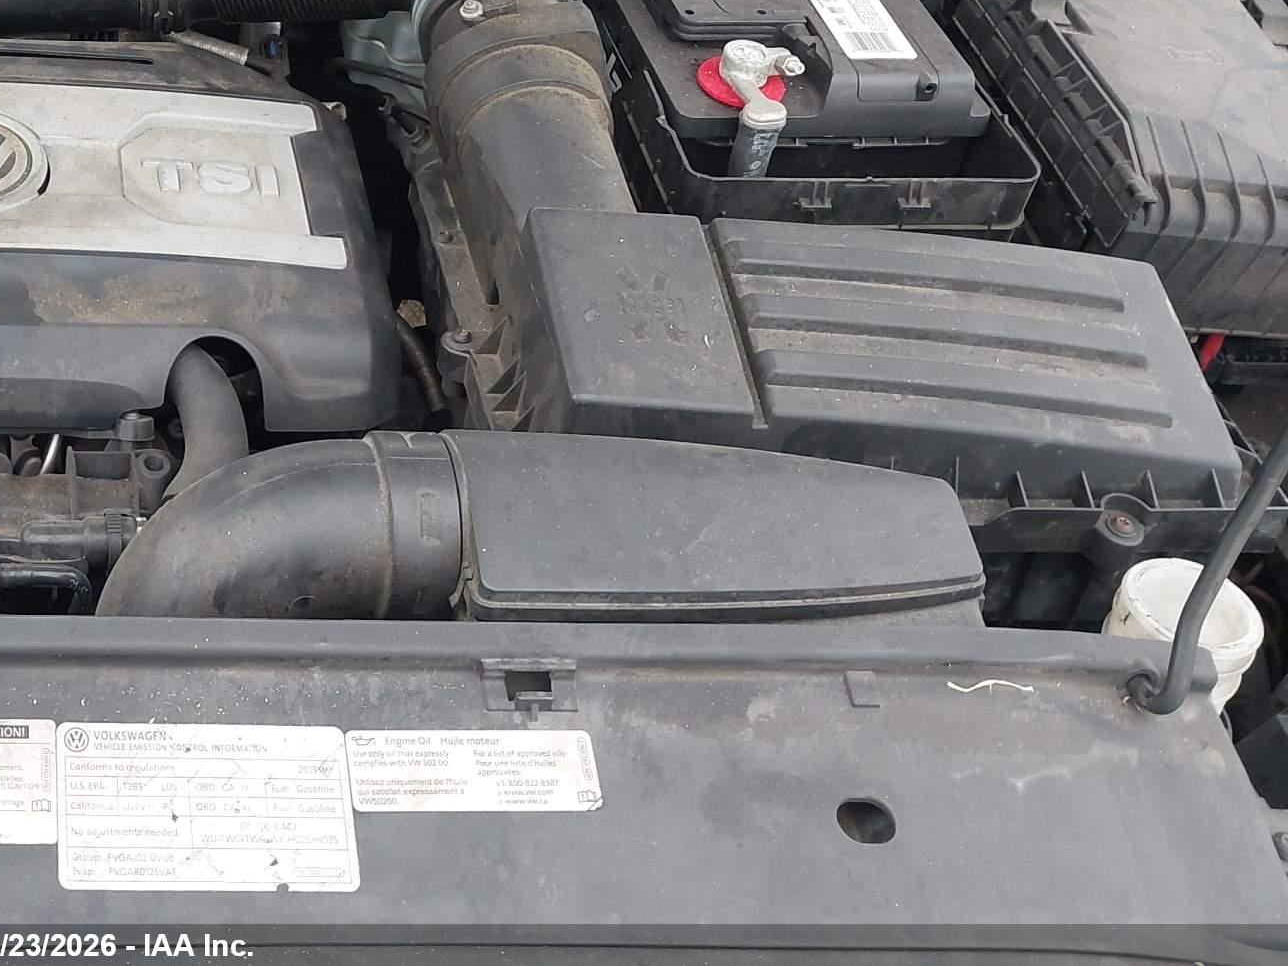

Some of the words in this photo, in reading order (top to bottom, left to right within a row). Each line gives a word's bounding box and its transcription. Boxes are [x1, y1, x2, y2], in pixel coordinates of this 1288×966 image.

[141, 157, 283, 198] TSI
[93, 731, 167, 741] VOLKSWAGEN
[385, 737, 416, 748] Engine
[418, 737, 431, 745] Oil
[440, 737, 464, 745] Huile
[93, 743, 127, 751] VEHICLE
[129, 743, 167, 751] EMISSION
[211, 744, 268, 753] INFORMATION
[516, 750, 550, 760] approved
[69, 762, 113, 772] Conforms
[114, 763, 124, 772] to
[408, 759, 422, 767] VW
[296, 785, 335, 794] Gasoline
[297, 804, 337, 813] Gasoline
